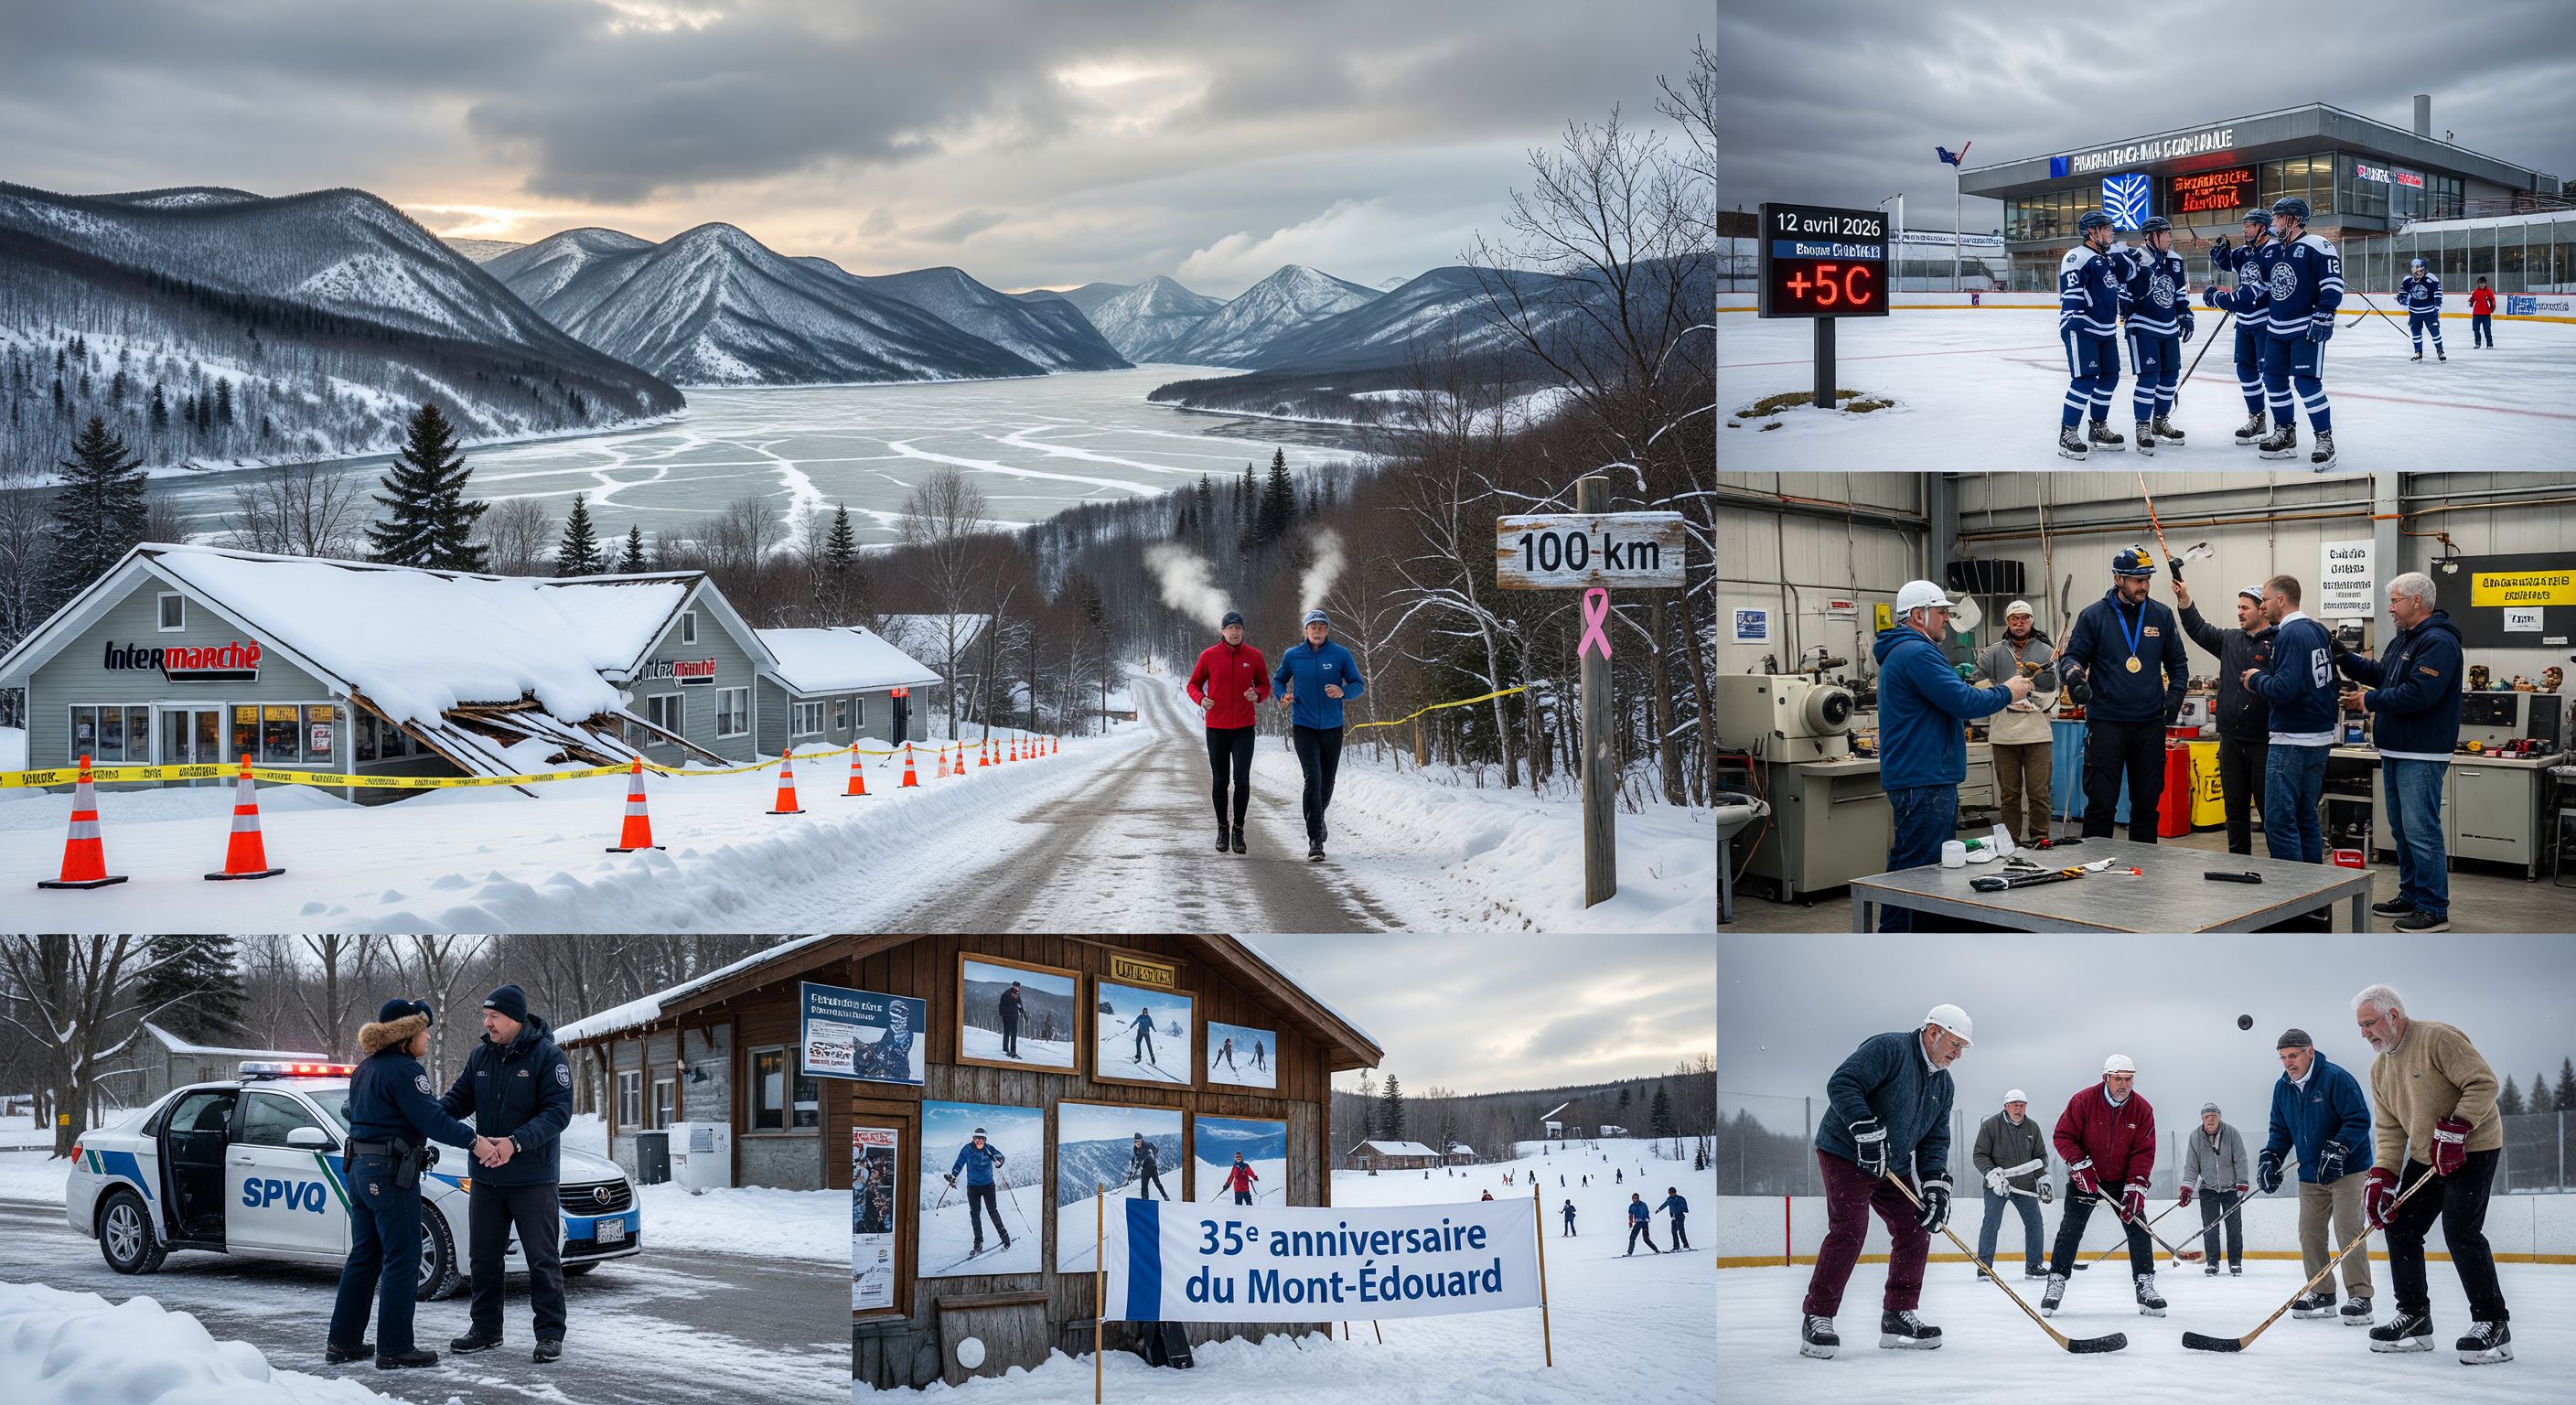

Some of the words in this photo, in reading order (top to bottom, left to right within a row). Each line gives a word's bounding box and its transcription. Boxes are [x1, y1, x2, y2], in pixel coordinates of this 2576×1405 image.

[1777, 213, 1798, 231] 12
[1803, 217, 1838, 234] avril
[1842, 219, 1881, 237] 2026
[1519, 531, 1589, 572] 100
[1604, 532, 1660, 571] km
[242, 1177, 327, 1215] SPVQ
[1270, 1217, 1487, 1258] anniversaire
[1185, 1264, 1235, 1304] du
[1247, 1258, 1503, 1304] Mont-Édouard
